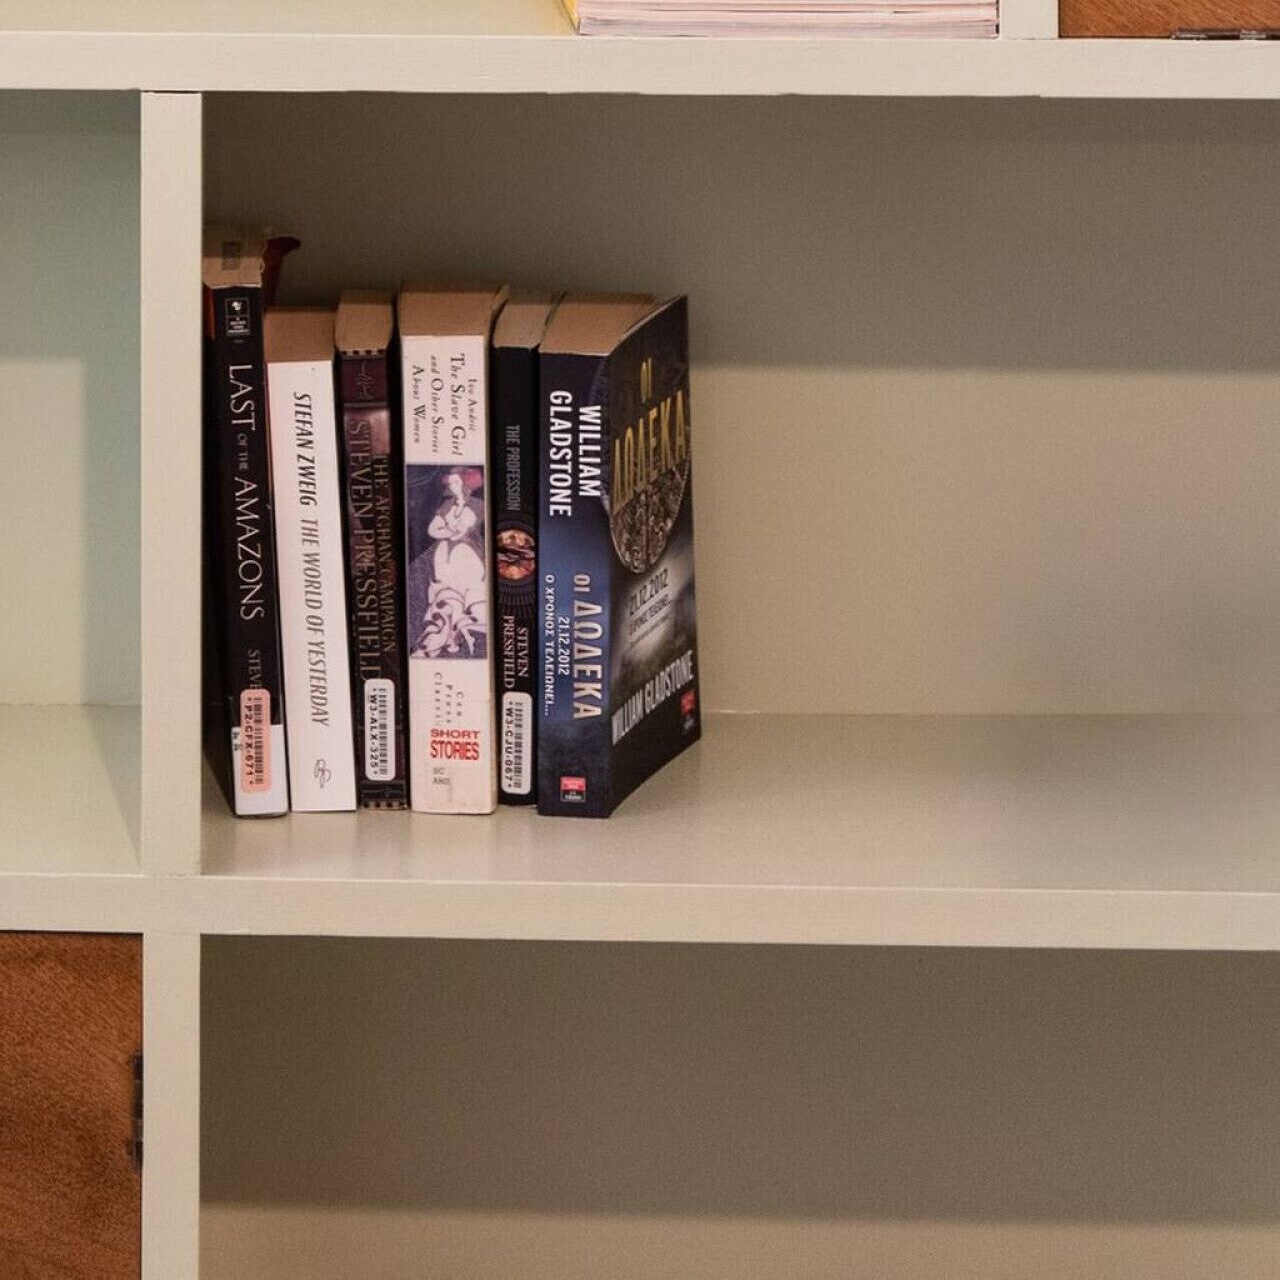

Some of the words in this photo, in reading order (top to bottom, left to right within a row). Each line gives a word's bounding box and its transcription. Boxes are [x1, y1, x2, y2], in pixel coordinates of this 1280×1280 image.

[413, 365, 425, 401] About
[430, 355, 441, 375] and
[450, 352, 466, 380] The
[228, 364, 257, 431] LAST
[294, 391, 315, 450] STEFAN
[430, 378, 445, 413] Other
[450, 384, 467, 421] Slave
[413, 404, 426, 444] Women
[431, 416, 445, 454] Stories
[450, 425, 467, 457] Girl
[505, 424, 521, 446] THE
[349, 420, 375, 518] STEVEN
[372, 454, 389, 489] THE
[548, 389, 573, 517] GLADSTONE
[578, 404, 602, 498] WILLIAM
[297, 454, 318, 507] ZWEIG
[505, 446, 521, 512] PROFESSION
[234, 476, 265, 620] AMAZONS
[300, 518, 321, 547] THE
[373, 496, 393, 564] AFGHAN
[303, 552, 323, 611] WORLD
[306, 614, 326, 637] OF
[378, 567, 397, 654] CAMPAIGN
[544, 587, 557, 638] ΧΡΟΝΟΣ
[502, 615, 516, 689] PRESSFIELD
[516, 626, 529, 678] STEVEN
[557, 615, 571, 677] 21.12.2012
[573, 600, 603, 720] ΔΩΔΕΚΑ
[307, 640, 330, 728] YESTERDAY
[430, 728, 481, 740] SHORT
[430, 740, 480, 761] STORIES
